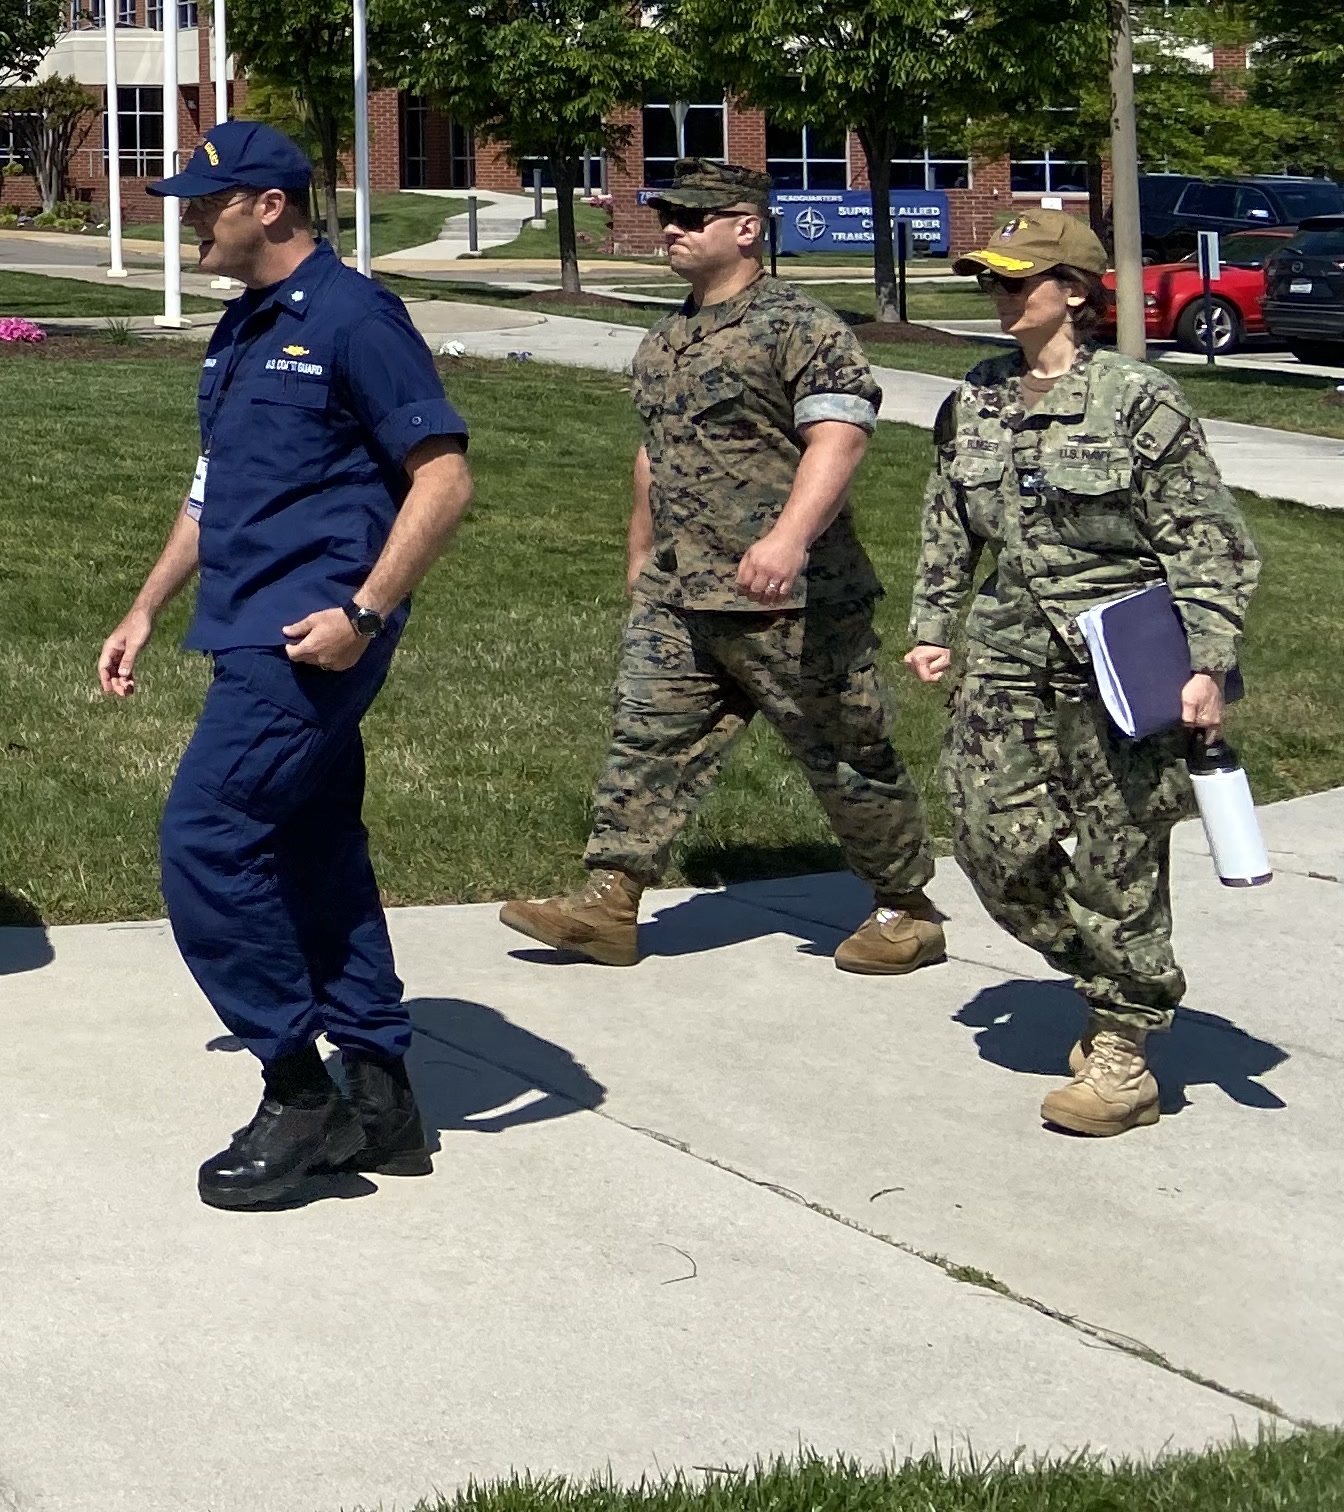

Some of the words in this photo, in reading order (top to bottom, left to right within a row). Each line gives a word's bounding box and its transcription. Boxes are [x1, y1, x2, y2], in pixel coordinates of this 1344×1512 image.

[776, 194, 843, 202] HEADQUARTERS
[838, 206, 896, 216] SUPRE
[898, 206, 940, 216] ALLIED
[831, 232, 941, 241] TRANSTION
[297, 362, 323, 375] GUARD
